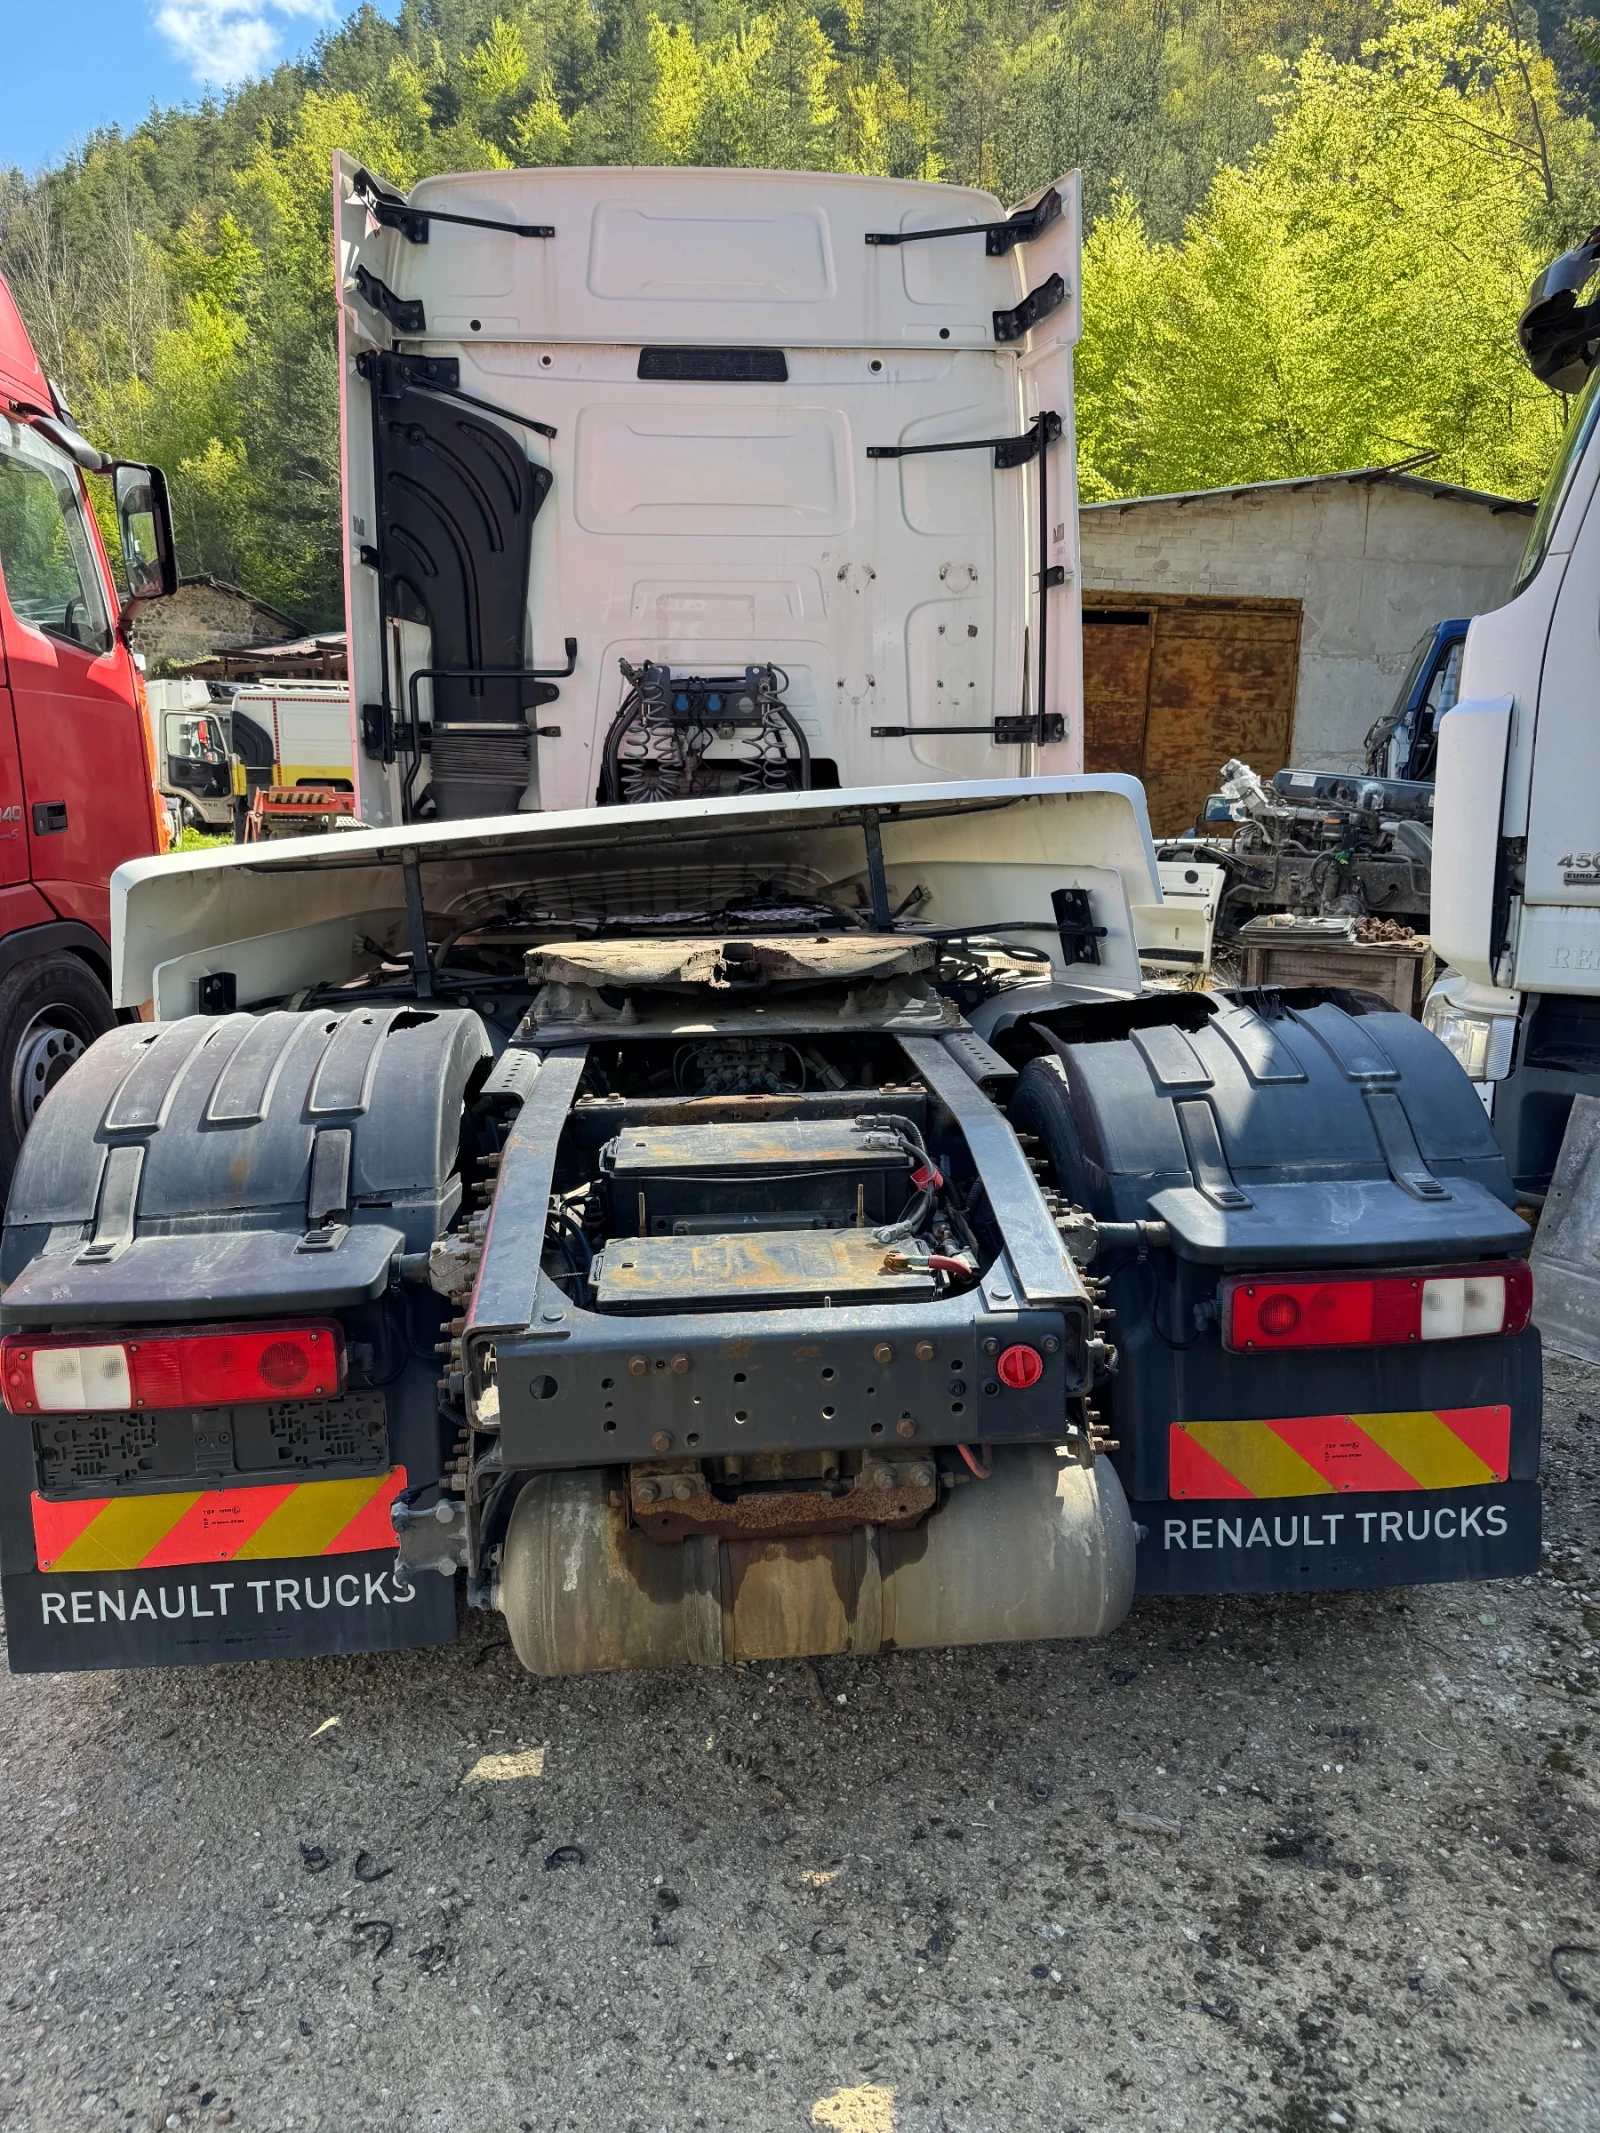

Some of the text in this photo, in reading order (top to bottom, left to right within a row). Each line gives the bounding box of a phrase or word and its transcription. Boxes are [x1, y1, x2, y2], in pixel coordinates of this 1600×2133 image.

[0, 806, 21, 822] 40
[1164, 1505, 1508, 1549] RENAULT TRUCKS
[41, 1571, 416, 1625] RENAULT TRUCKS
